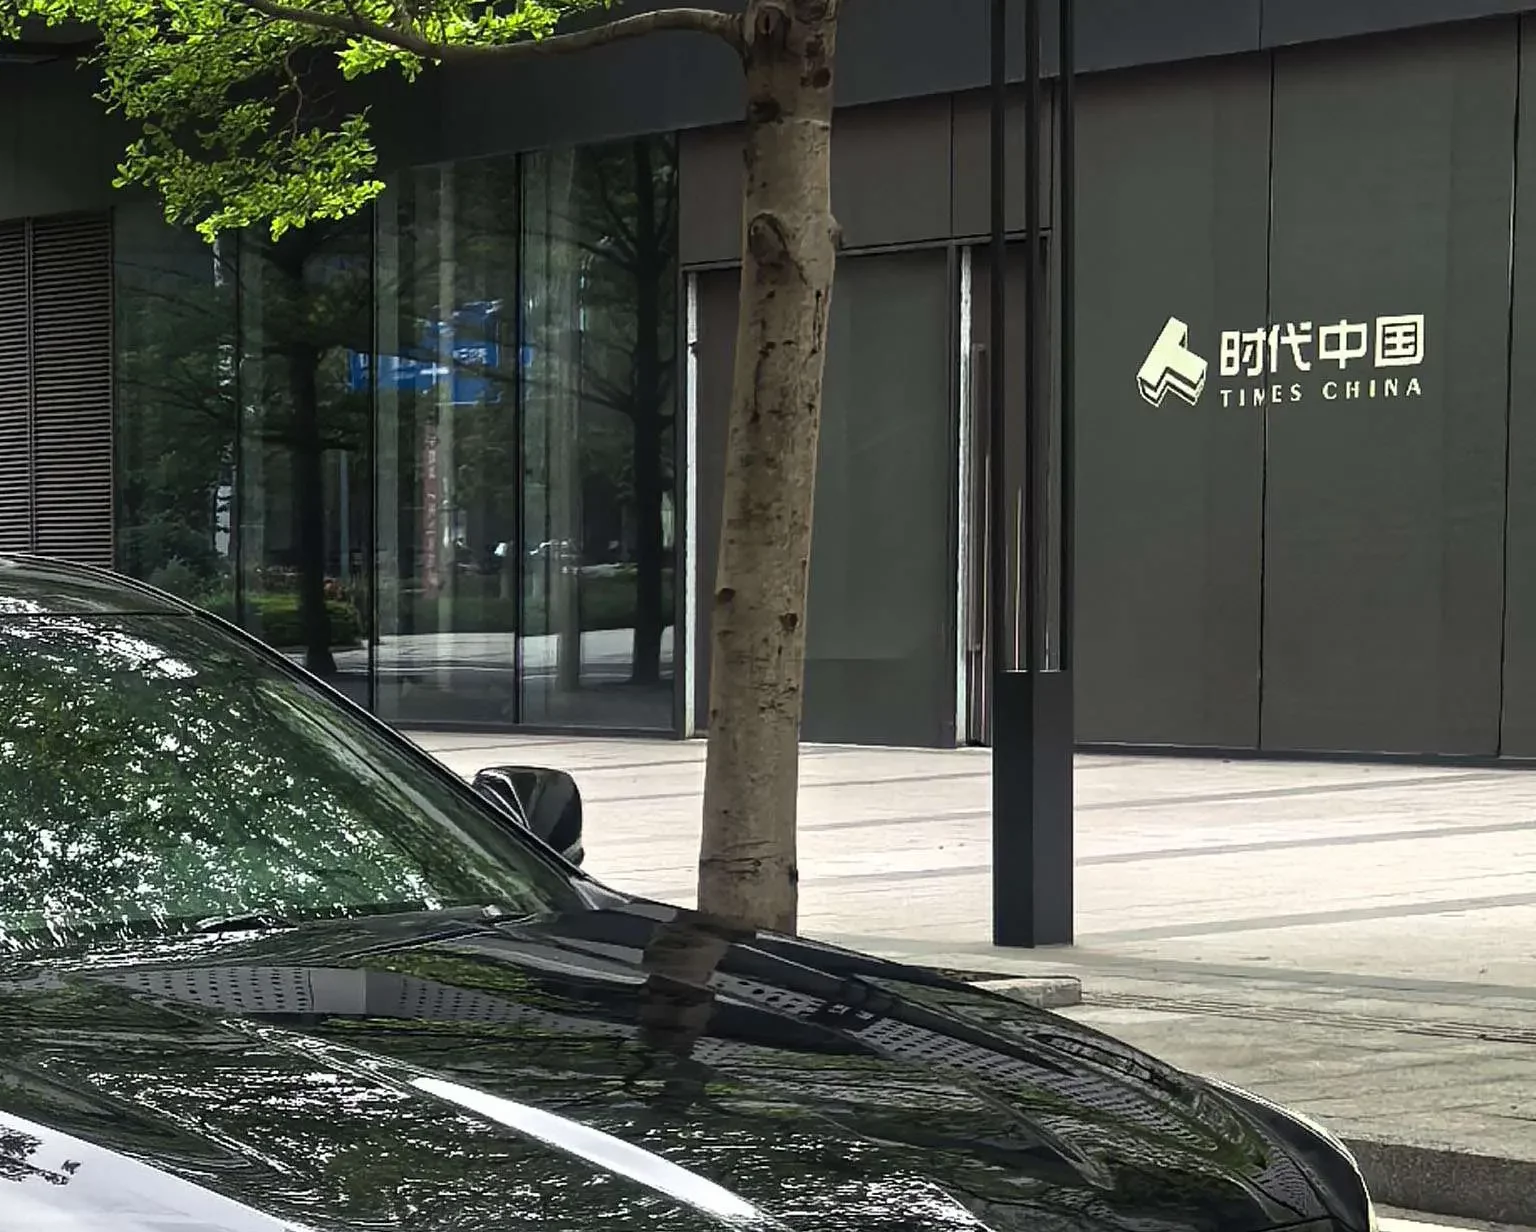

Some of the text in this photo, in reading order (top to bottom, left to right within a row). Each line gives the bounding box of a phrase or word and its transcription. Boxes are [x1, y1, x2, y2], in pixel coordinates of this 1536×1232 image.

[1219, 314, 1424, 377] 时代中国
[1219, 377, 1422, 408] TIMES CHINA
